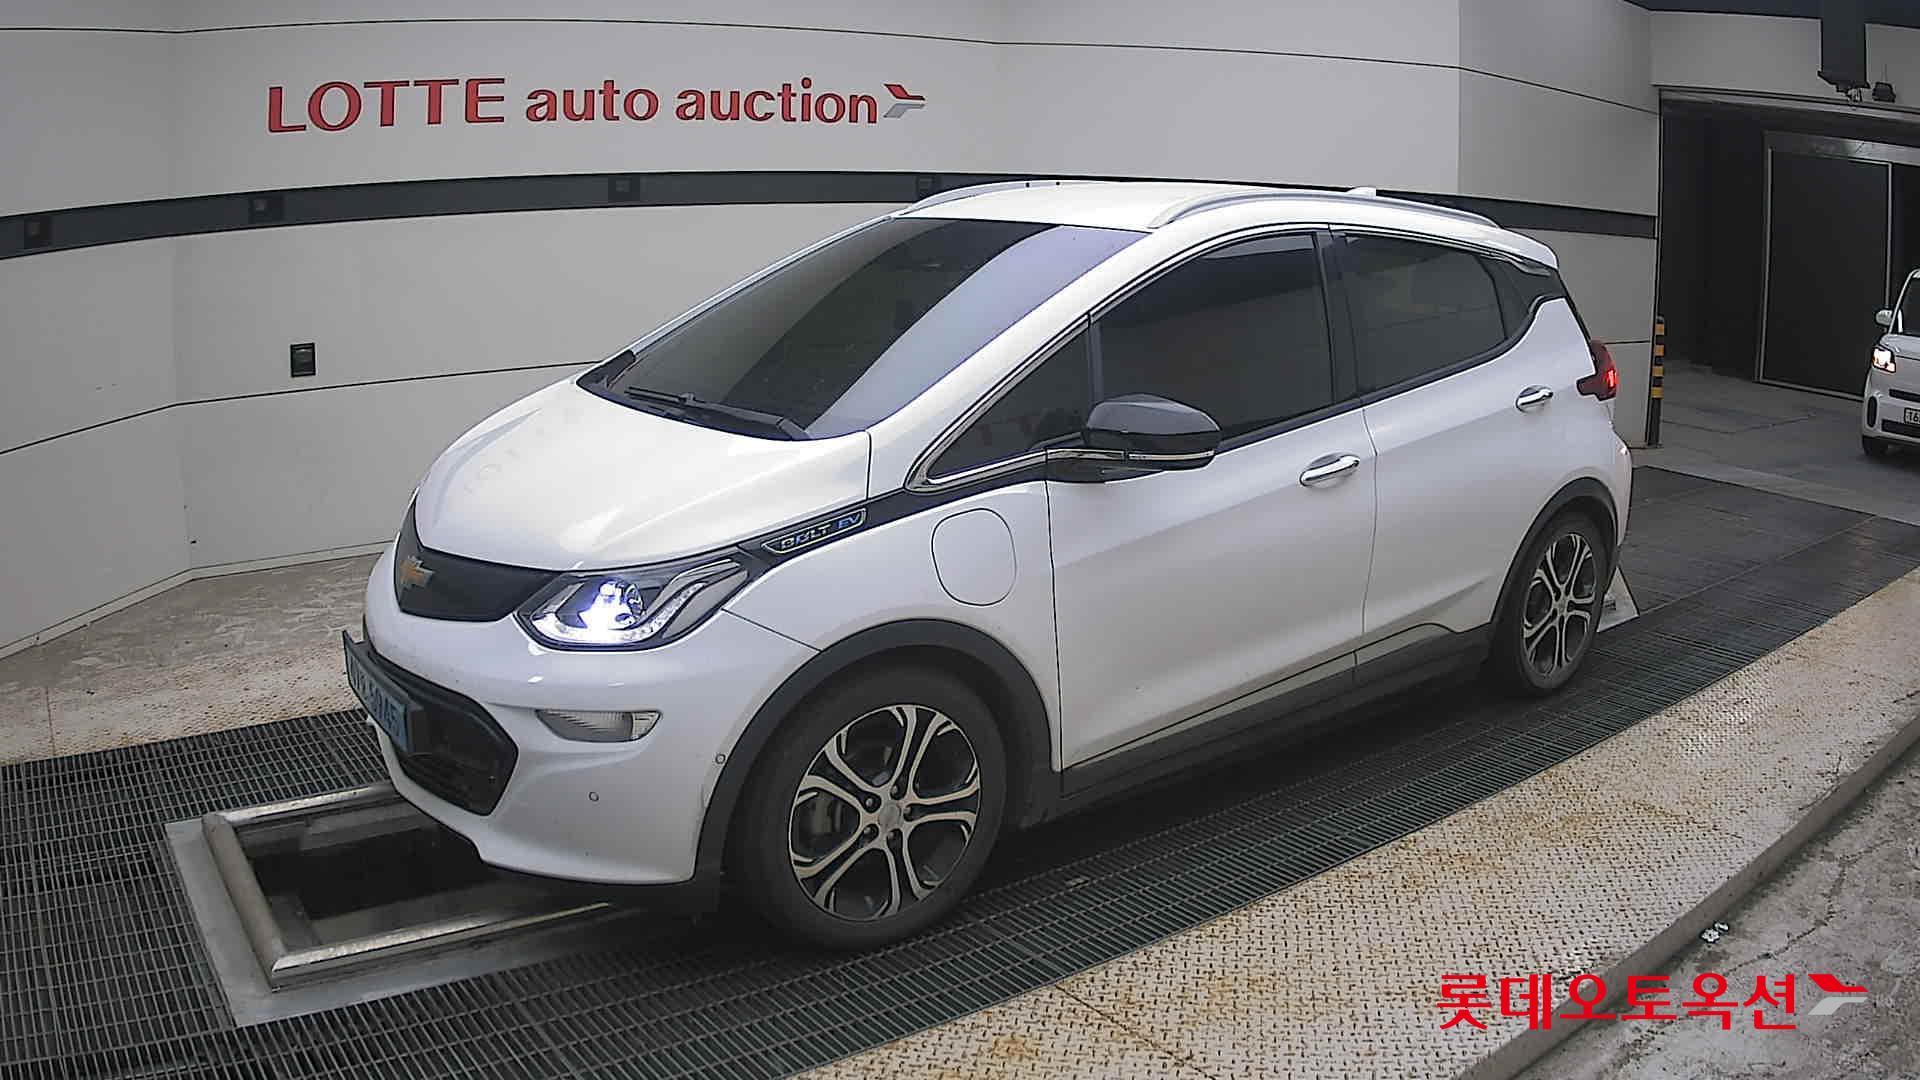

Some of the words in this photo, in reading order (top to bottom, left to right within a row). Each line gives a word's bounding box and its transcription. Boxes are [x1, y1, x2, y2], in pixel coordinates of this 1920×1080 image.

[268, 78, 505, 133] LOTTE
[526, 79, 659, 122] auto
[675, 78, 878, 124] auction
[838, 513, 861, 529] EV
